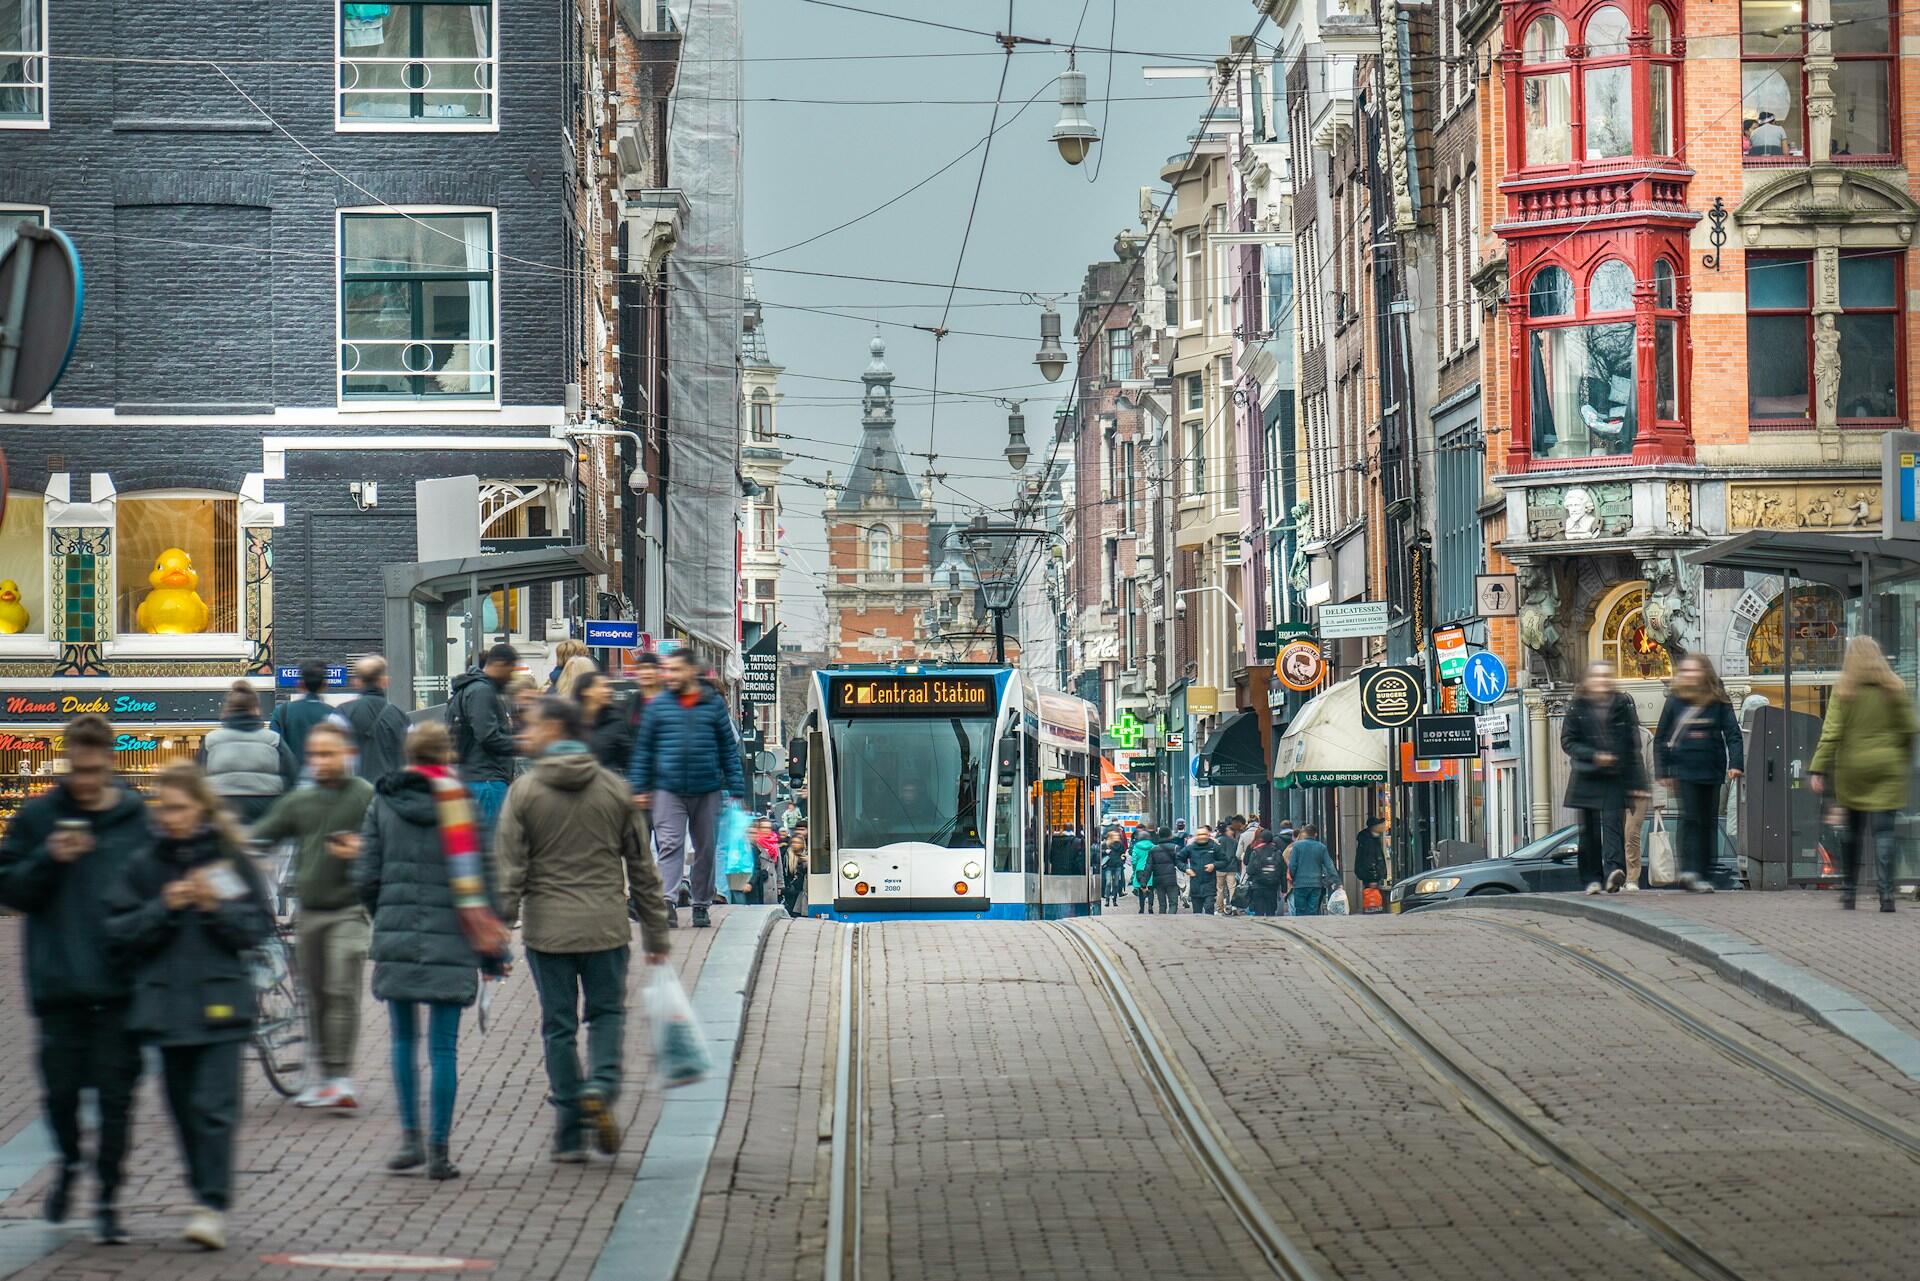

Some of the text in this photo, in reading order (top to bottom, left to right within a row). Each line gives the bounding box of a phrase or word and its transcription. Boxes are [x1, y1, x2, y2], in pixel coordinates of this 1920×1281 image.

[1325, 605, 1382, 615] DELICATESSEN
[590, 630, 633, 638] Samsonite
[749, 654, 776, 662] TATTOOS
[743, 672, 775, 681] ATTOOS &
[744, 682, 775, 691] IERCINGS
[750, 693, 775, 701] TATTOOS
[844, 681, 985, 704] 2 Centraal Station
[6, 695, 157, 713] Mama Ducks Store
[1422, 730, 1471, 738] BODYCULT
[0, 734, 46, 751] Mama
[113, 733, 158, 752] Store
